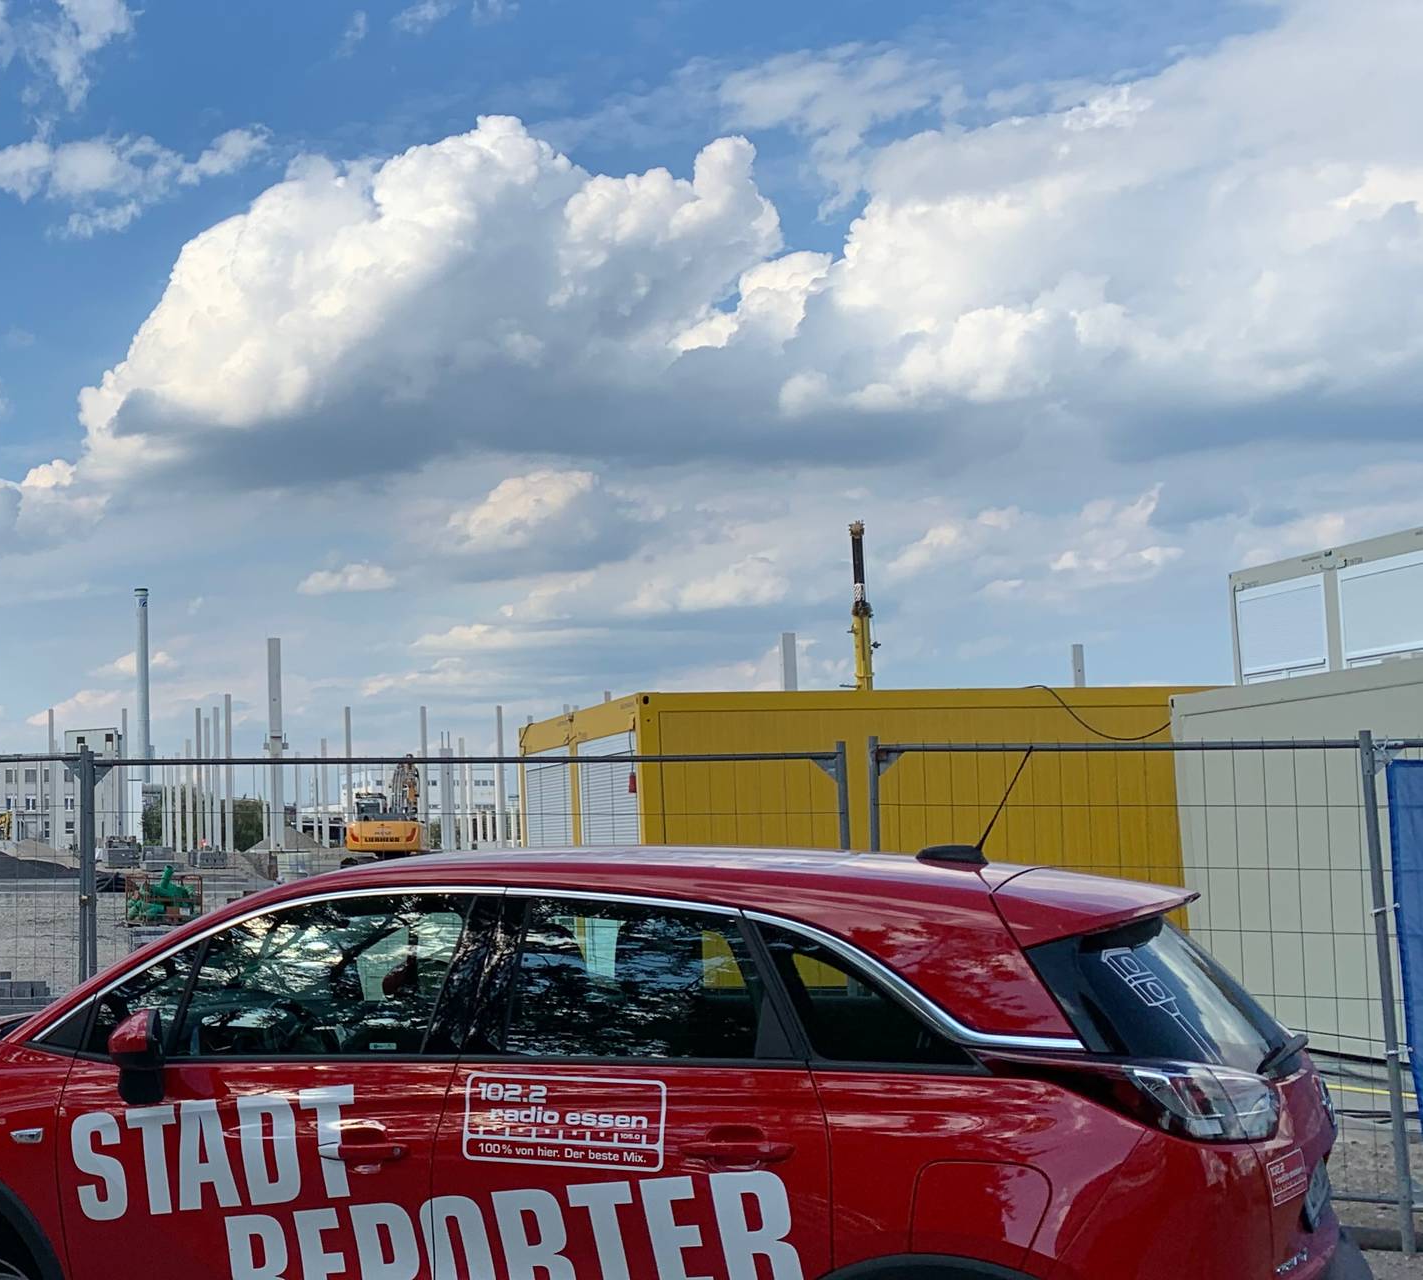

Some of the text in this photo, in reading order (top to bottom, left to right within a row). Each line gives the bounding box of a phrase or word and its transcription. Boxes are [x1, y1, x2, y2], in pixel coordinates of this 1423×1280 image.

[478, 1082, 548, 1104] 102.2
[489, 1106, 648, 1129] radio essen
[71, 1083, 354, 1222] STADT
[515, 1147, 534, 1157] von
[537, 1146, 560, 1158] hier.
[565, 1148, 584, 1159] Der
[588, 1149, 619, 1162] beste
[623, 1151, 647, 1163] Mix.
[224, 1171, 803, 1280] REPORTER
